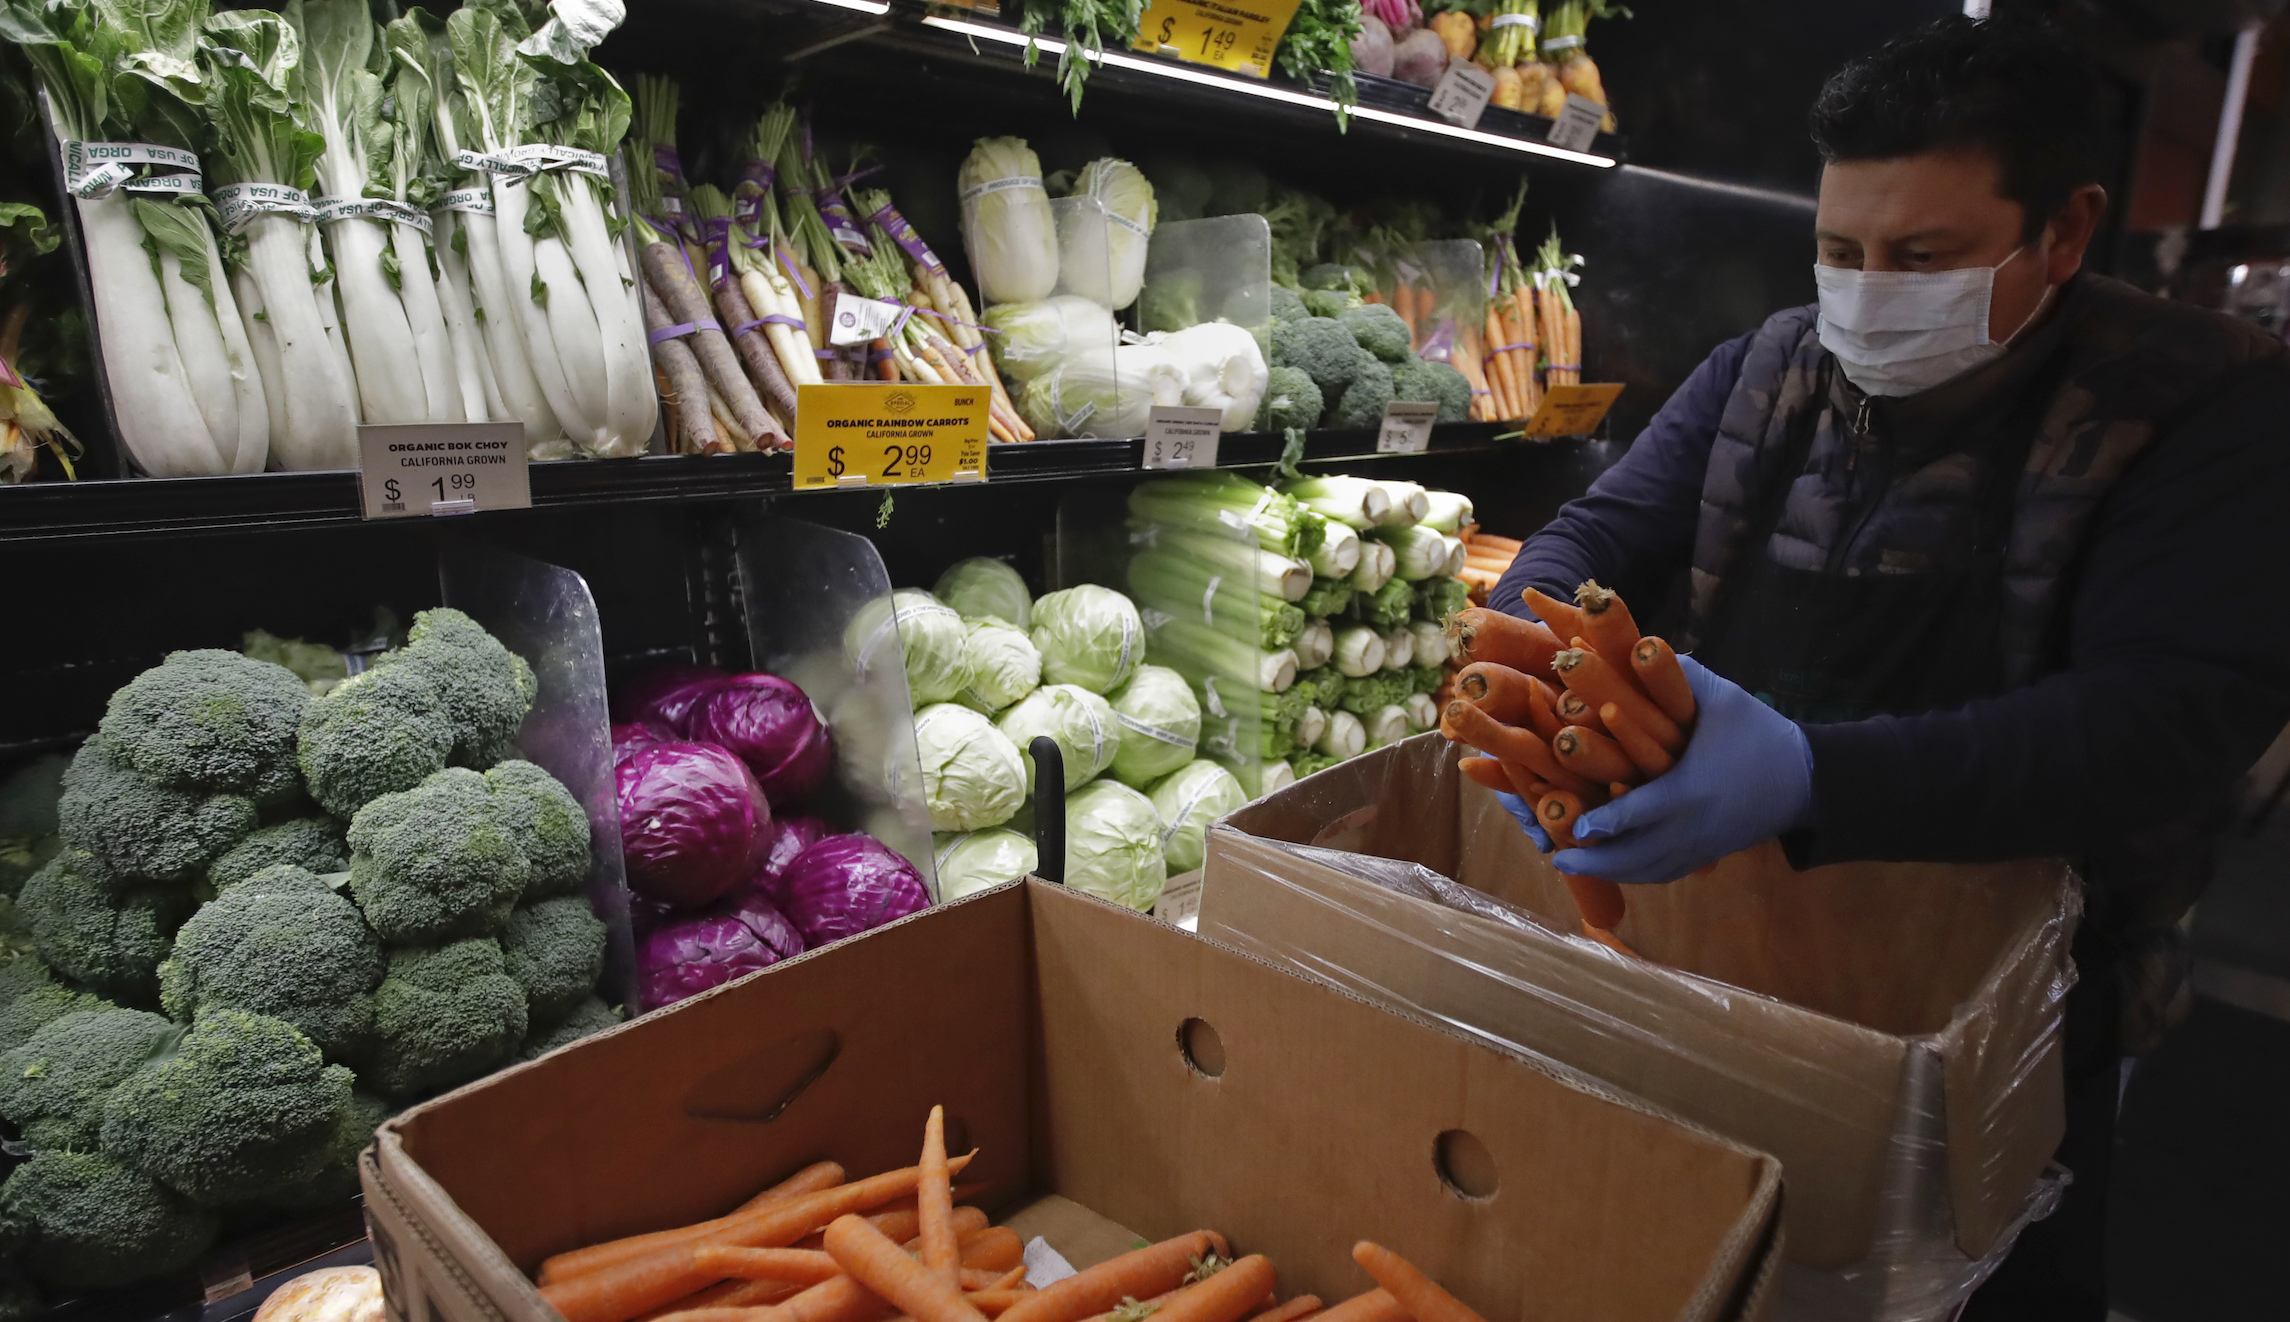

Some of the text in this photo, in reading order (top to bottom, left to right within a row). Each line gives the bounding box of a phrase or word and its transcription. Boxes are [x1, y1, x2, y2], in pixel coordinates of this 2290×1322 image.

[1157, 16, 1176, 44] $
[1213, 50, 1225, 60] EA
[146, 148, 176, 161] USA
[181, 155, 195, 166] OF
[249, 186, 278, 199] USA
[282, 190, 300, 202] OF
[338, 204, 363, 216] USA
[954, 398, 974, 406] BUNCH
[827, 418, 969, 428] ORGANIC RAINBOW CARROTS
[866, 430, 934, 439] CALIFORNIA GROWN
[1165, 427, 1192, 435] CALIFORNIA
[389, 441, 509, 452] ORGANIC BOK CHOY
[1154, 441, 1162, 456] $
[401, 455, 506, 467] CALIFORNIA GROWN
[827, 445, 845, 479] $
[910, 468, 925, 478] EA
[385, 478, 401, 503] $
